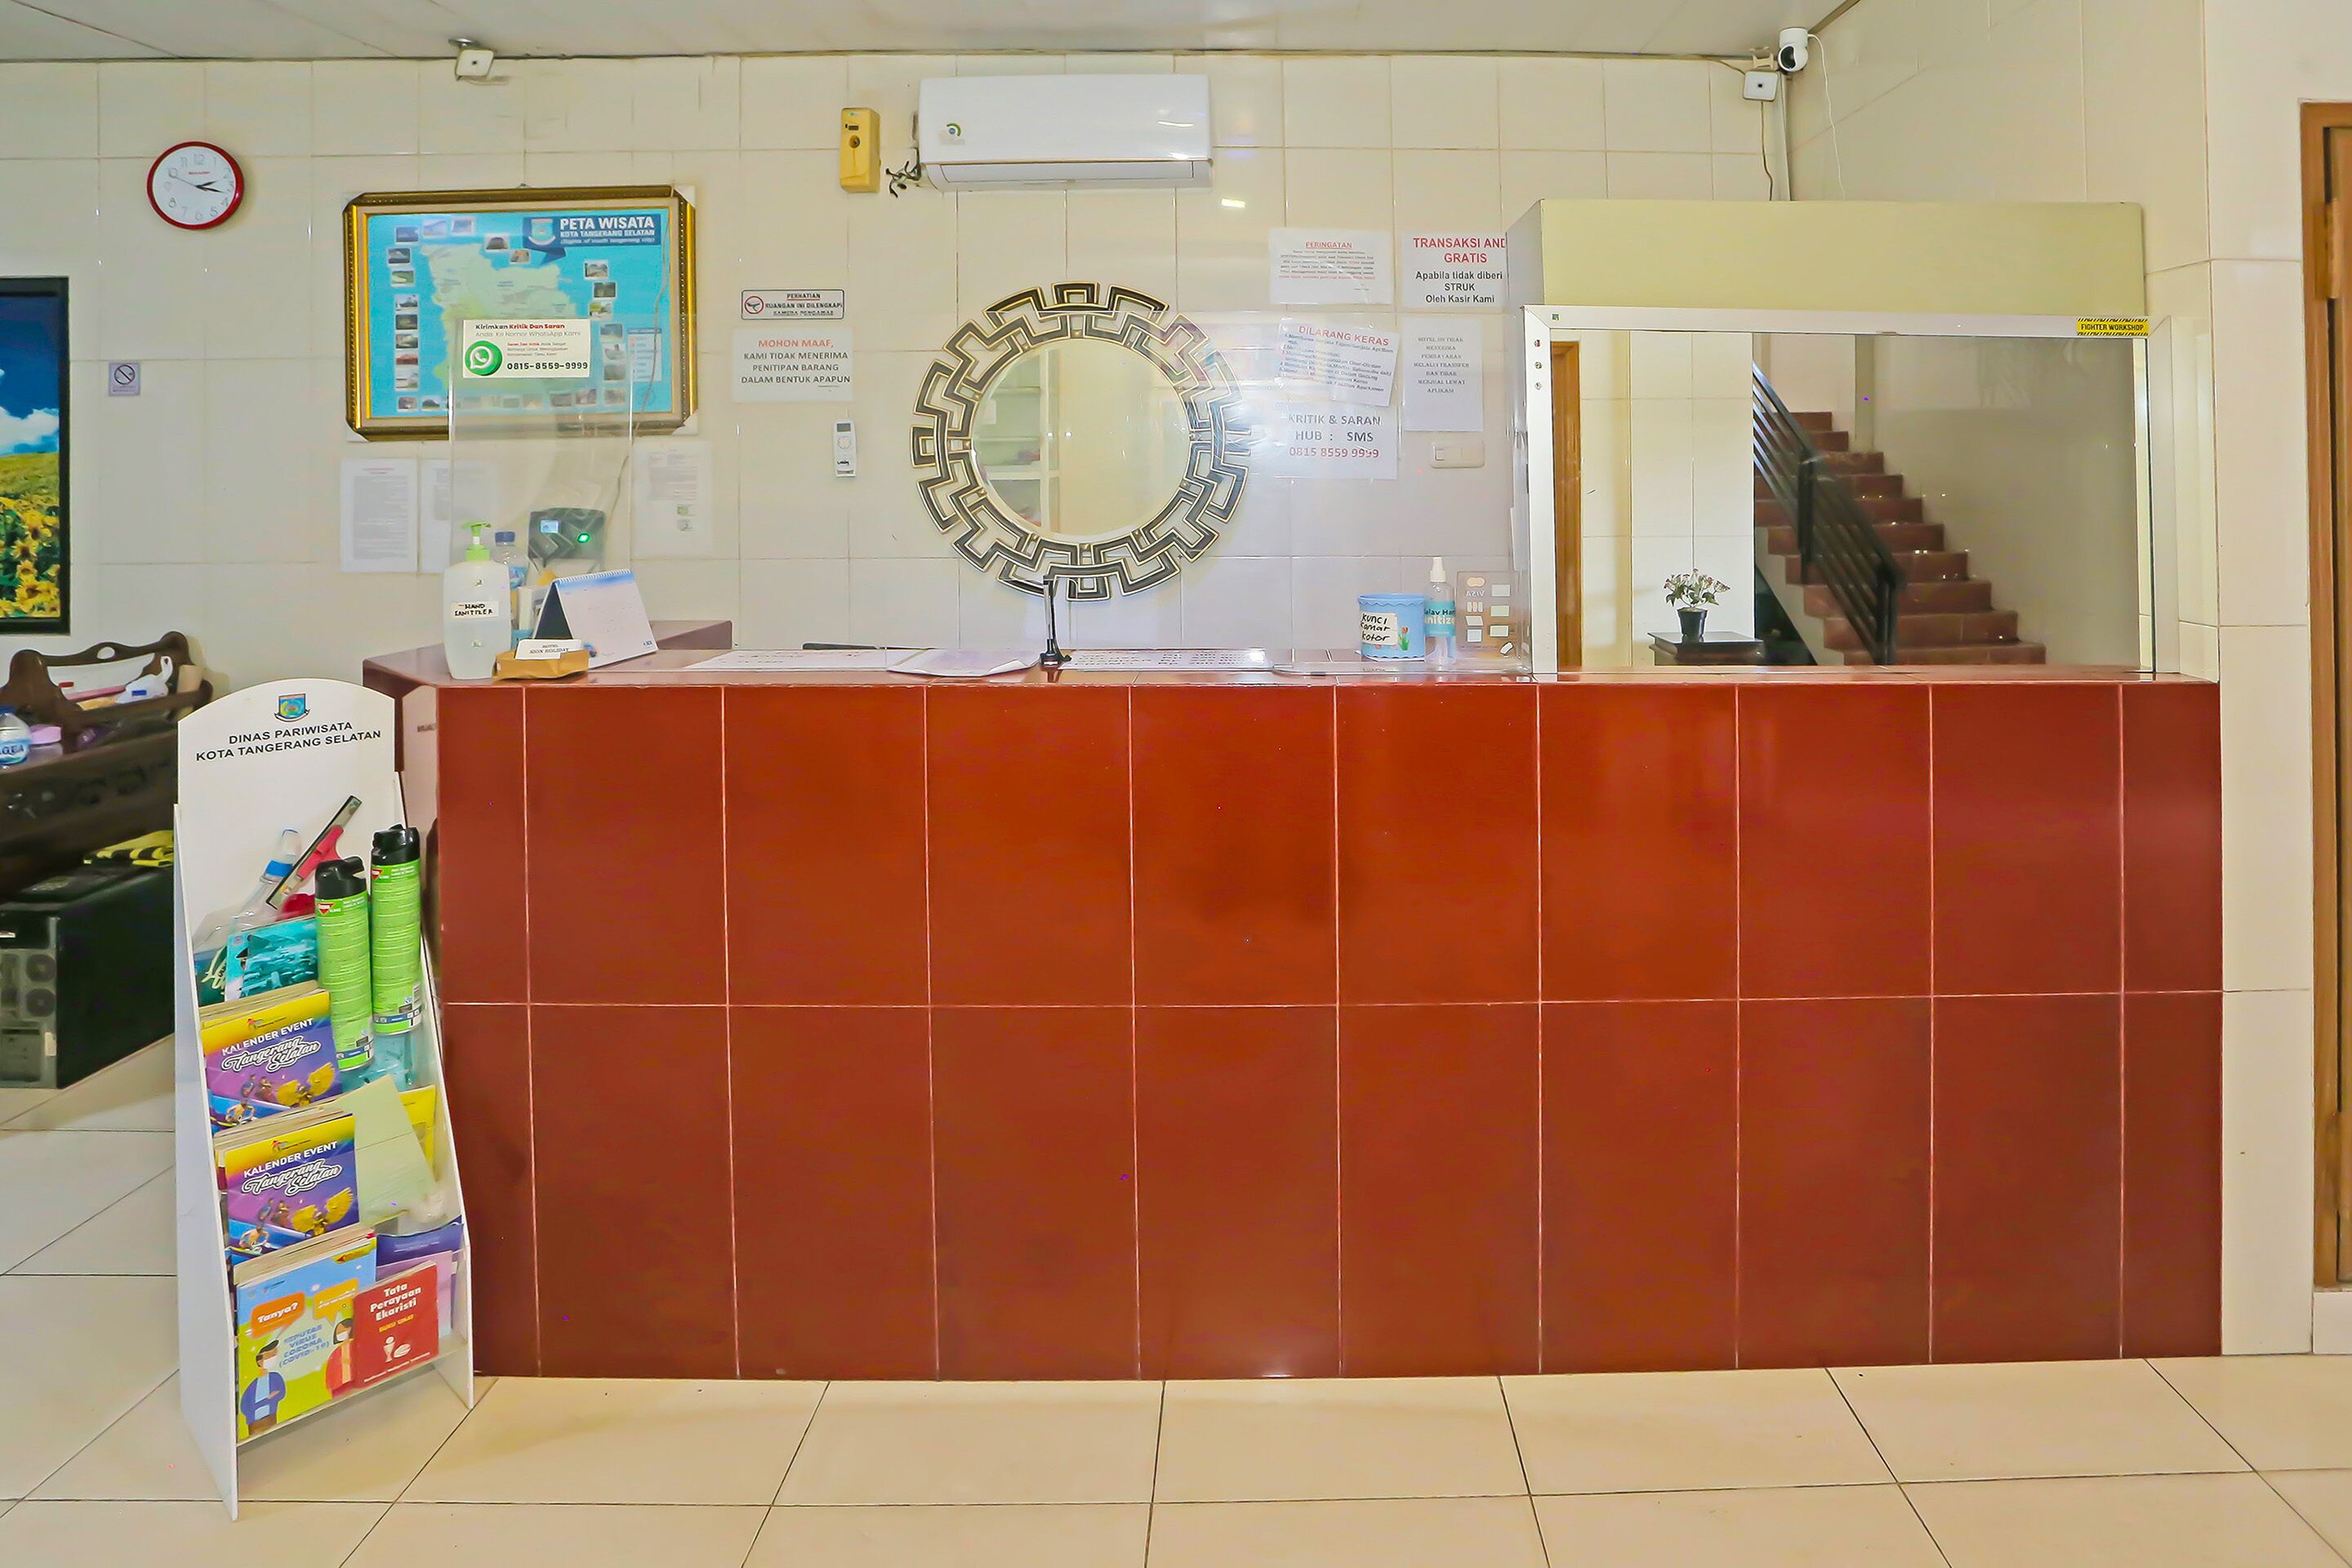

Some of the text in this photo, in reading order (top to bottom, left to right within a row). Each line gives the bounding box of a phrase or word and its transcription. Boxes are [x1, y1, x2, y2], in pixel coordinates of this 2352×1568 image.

[559, 216, 655, 230] PETA WISATA
[1413, 238, 1481, 248] TRANSAKSI
[1444, 252, 1487, 263] GRATIS
[1415, 271, 1503, 281] Apabila tidak diberi
[1444, 283, 1476, 291] STRUK
[1425, 295, 1494, 303] Oleh Kasir Kami
[801, 340, 834, 348] MAAF,
[1298, 325, 1352, 341] DILARANG
[1354, 334, 1390, 346] KERAS
[506, 362, 588, 370] 0815-8559-9999
[1289, 414, 1381, 425] KRITIK & SARAN
[1295, 430, 1322, 440] HUB
[1347, 431, 1374, 442] SMS
[1289, 447, 1379, 458] 0815 8559 9999
[229, 722, 353, 745] DINAS PARIWISATA
[195, 730, 381, 761] KOTA TANGERANG SELATAN
[221, 1031, 279, 1057] KALENDER
[280, 1018, 314, 1036] EVENT
[220, 1036, 305, 1072] Tangerang
[265, 1040, 322, 1073] Selatan
[243, 1152, 301, 1178] KALENDER
[304, 1141, 338, 1158] EVENT
[242, 1158, 327, 1196] Tangerang
[284, 1164, 343, 1197] Selatan
[369, 1286, 422, 1313] Perayaan
[383, 1283, 408, 1298] Tata
[257, 1302, 299, 1324] Tanya?
[375, 1297, 417, 1321] Ekaristi
